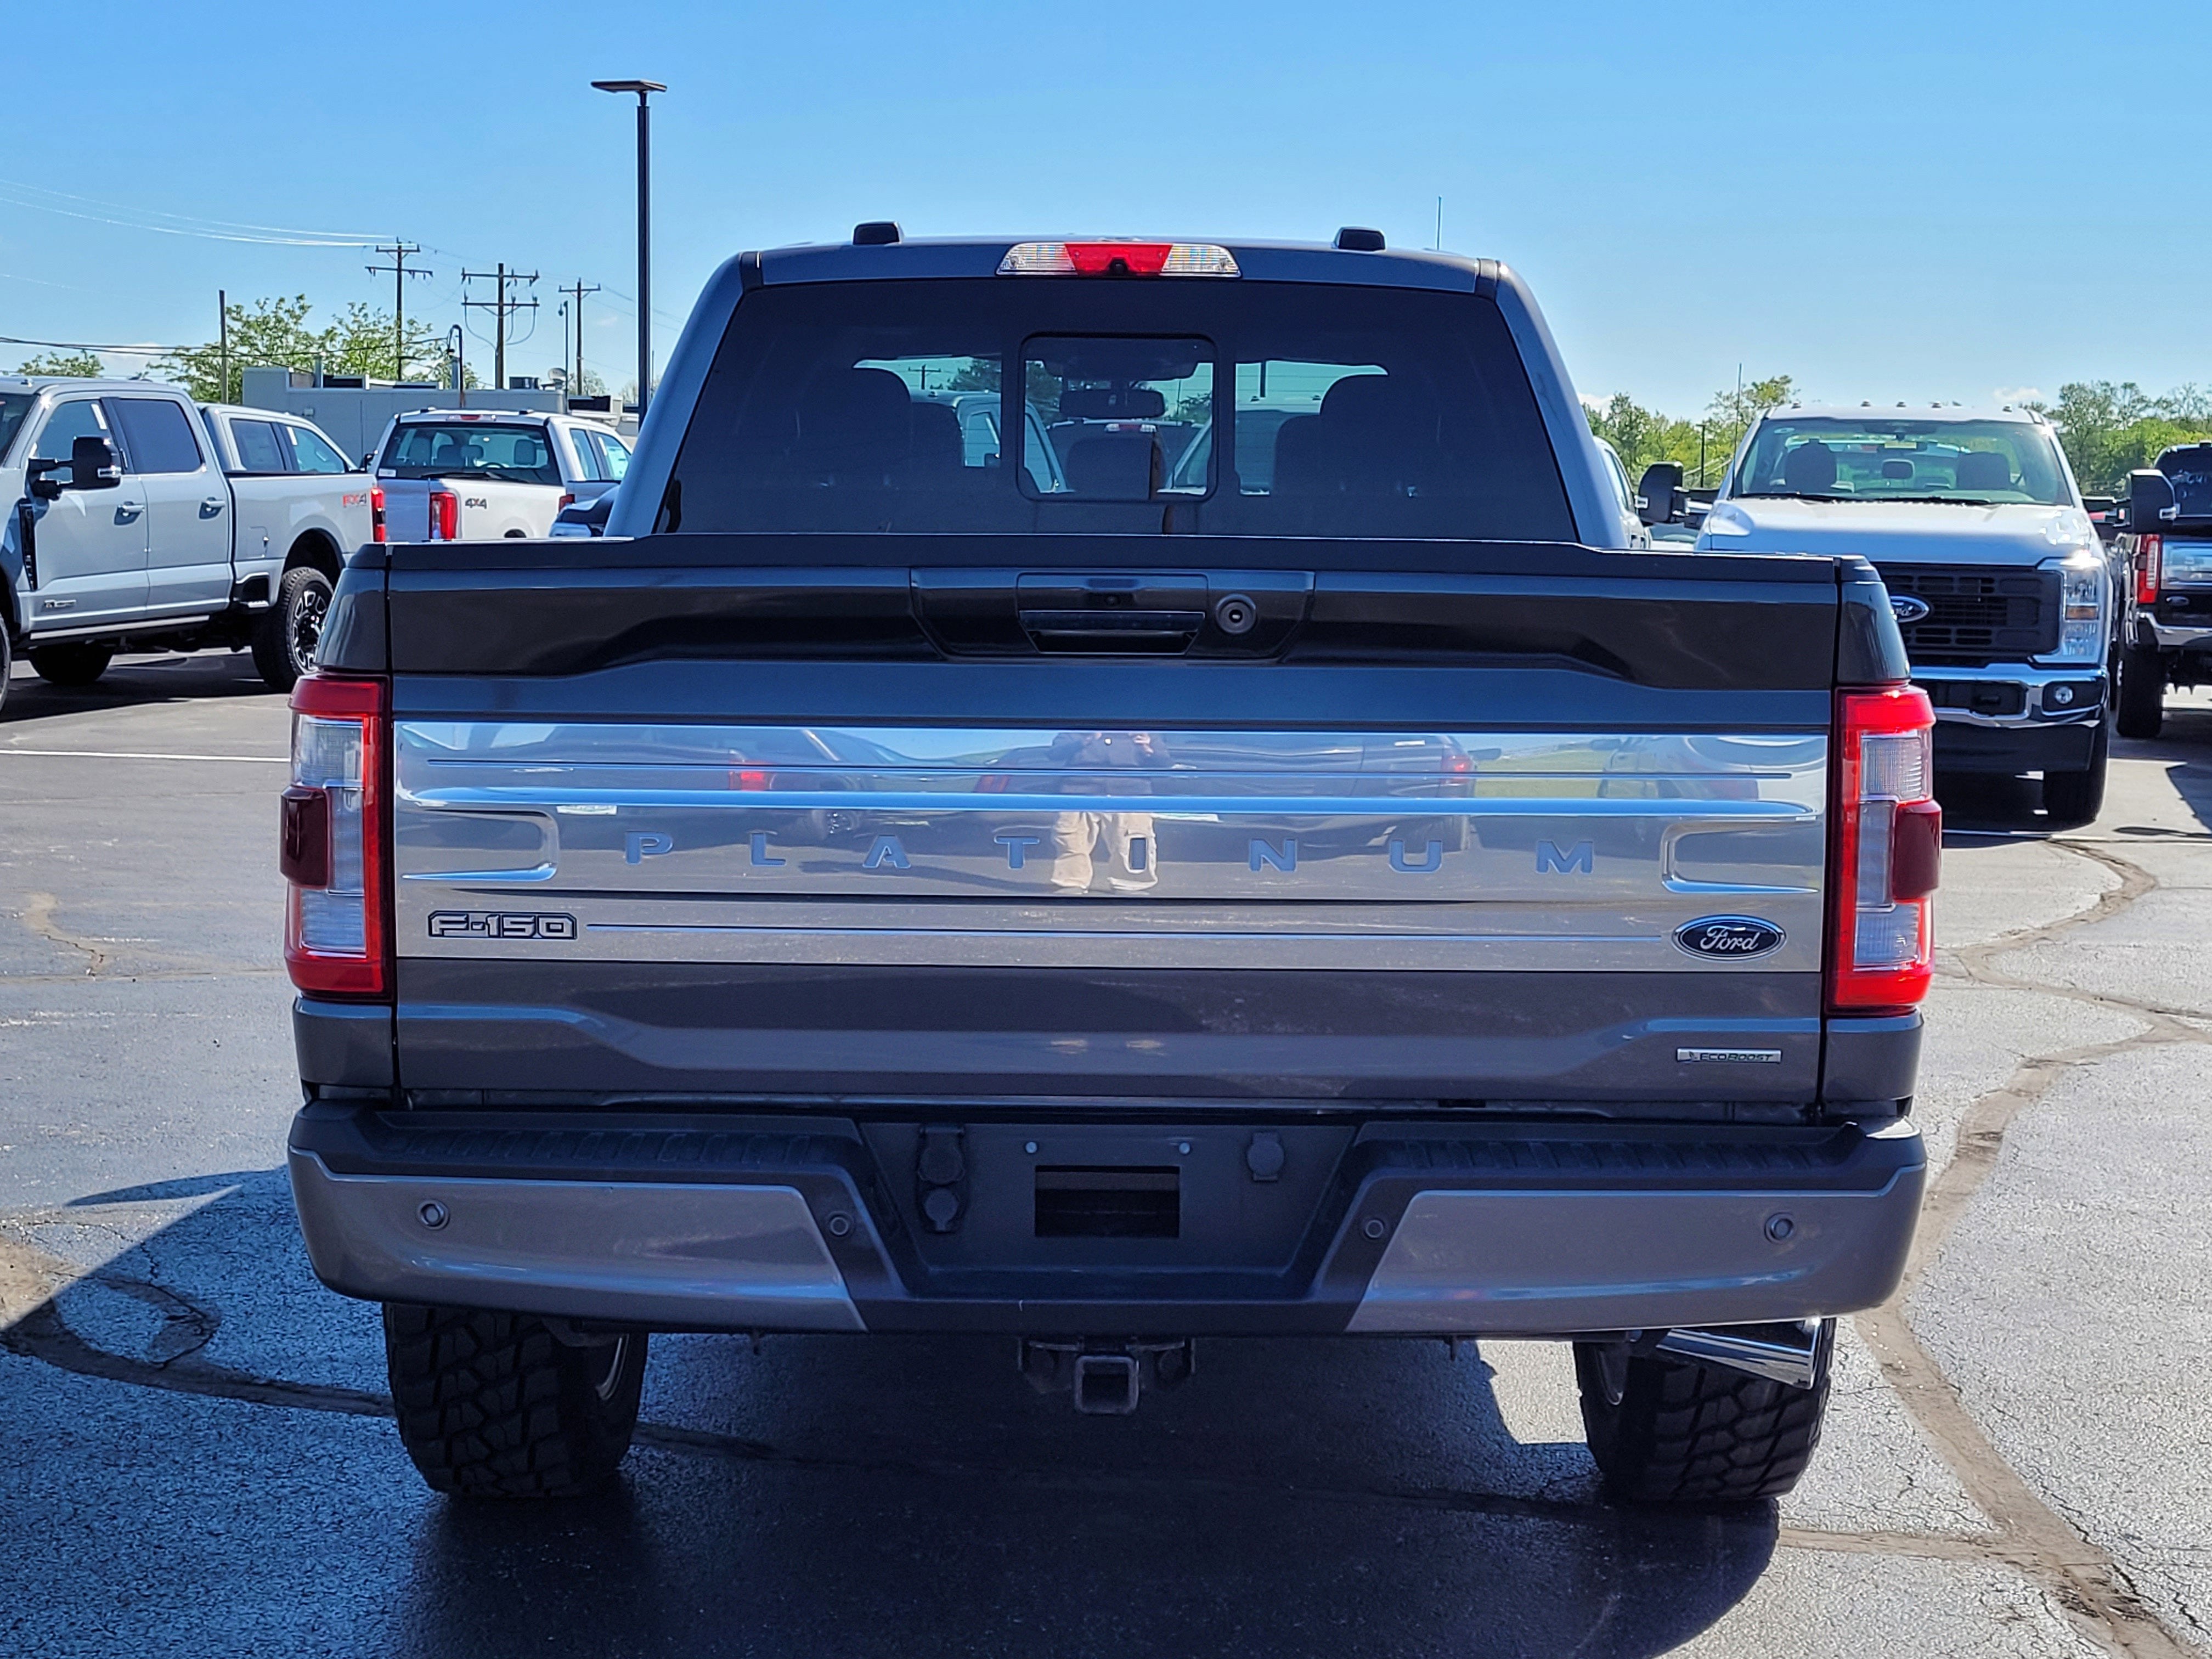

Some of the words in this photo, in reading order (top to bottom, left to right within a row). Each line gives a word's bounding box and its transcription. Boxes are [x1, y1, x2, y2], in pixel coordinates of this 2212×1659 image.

[625, 831, 1593, 874] PLATINUM
[428, 910, 577, 940] F-150
[1700, 925, 1760, 950] Ford
